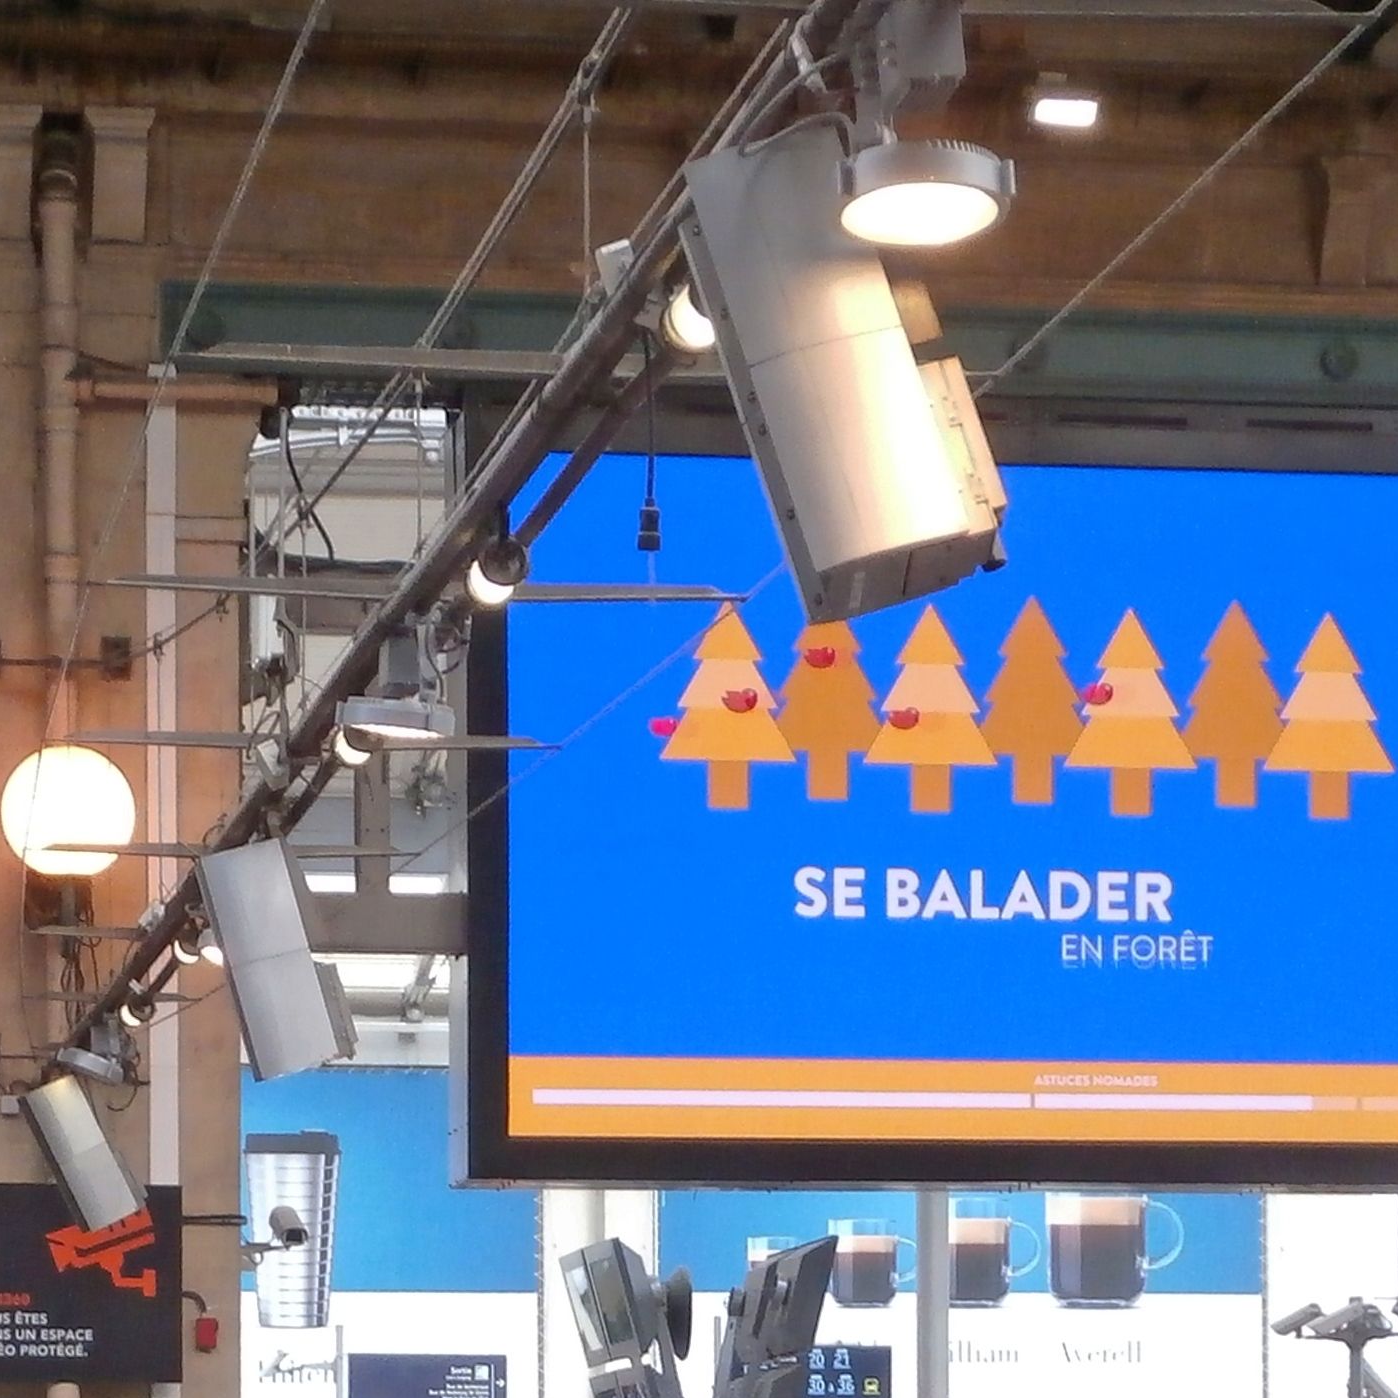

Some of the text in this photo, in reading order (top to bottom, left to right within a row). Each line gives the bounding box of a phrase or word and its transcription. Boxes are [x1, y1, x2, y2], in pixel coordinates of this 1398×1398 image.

[793, 866, 1174, 923] SE BALADER
[1061, 929, 1213, 964] EN FORÊT
[1034, 1074, 1158, 1088] ASTUCES NOMADES
[14, 1310, 48, 1325] ÊTES
[15, 1328, 37, 1341] UN
[40, 1328, 94, 1341] ESPACE
[19, 1342, 89, 1357] PROTÉGÉ.
